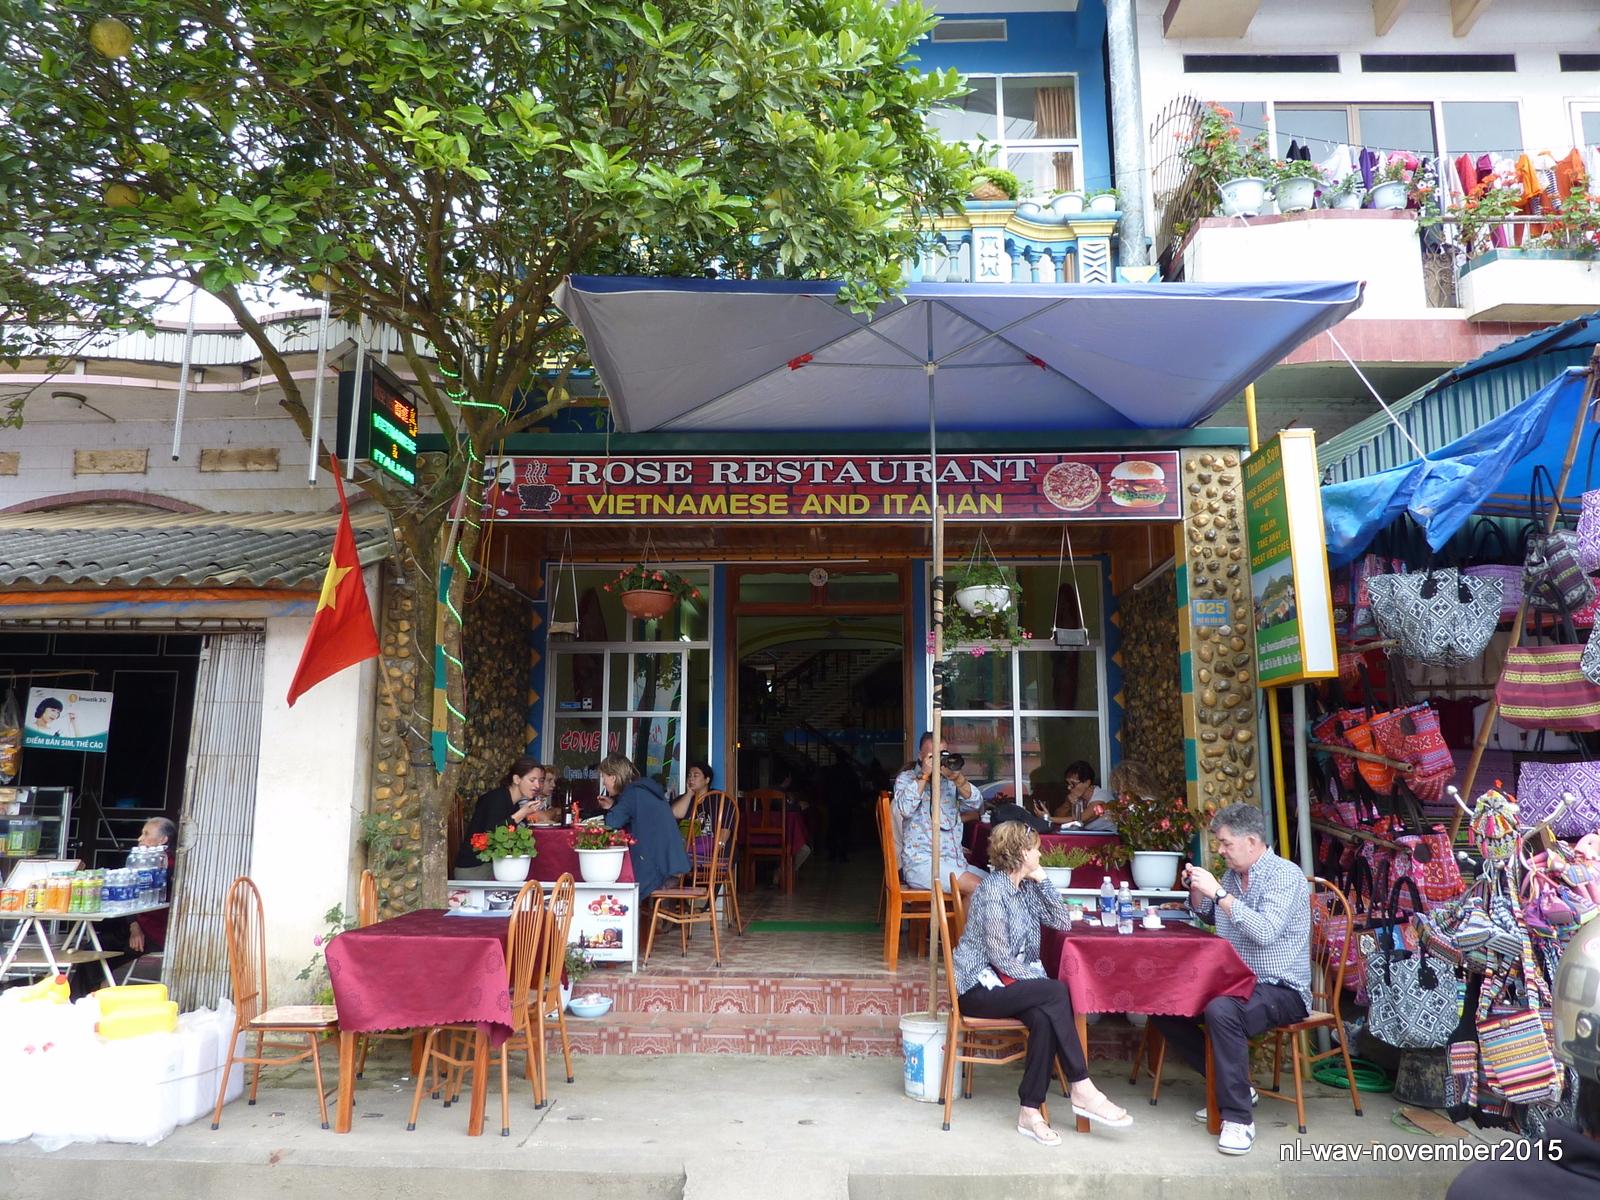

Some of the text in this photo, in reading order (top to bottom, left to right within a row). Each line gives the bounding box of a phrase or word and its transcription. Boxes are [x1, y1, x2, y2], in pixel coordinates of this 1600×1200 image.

[567, 458, 1037, 485] ROSE RESTAURANT
[586, 493, 789, 516] VIETNAMESE
[800, 493, 870, 516] AND
[1196, 602, 1225, 615] 025
